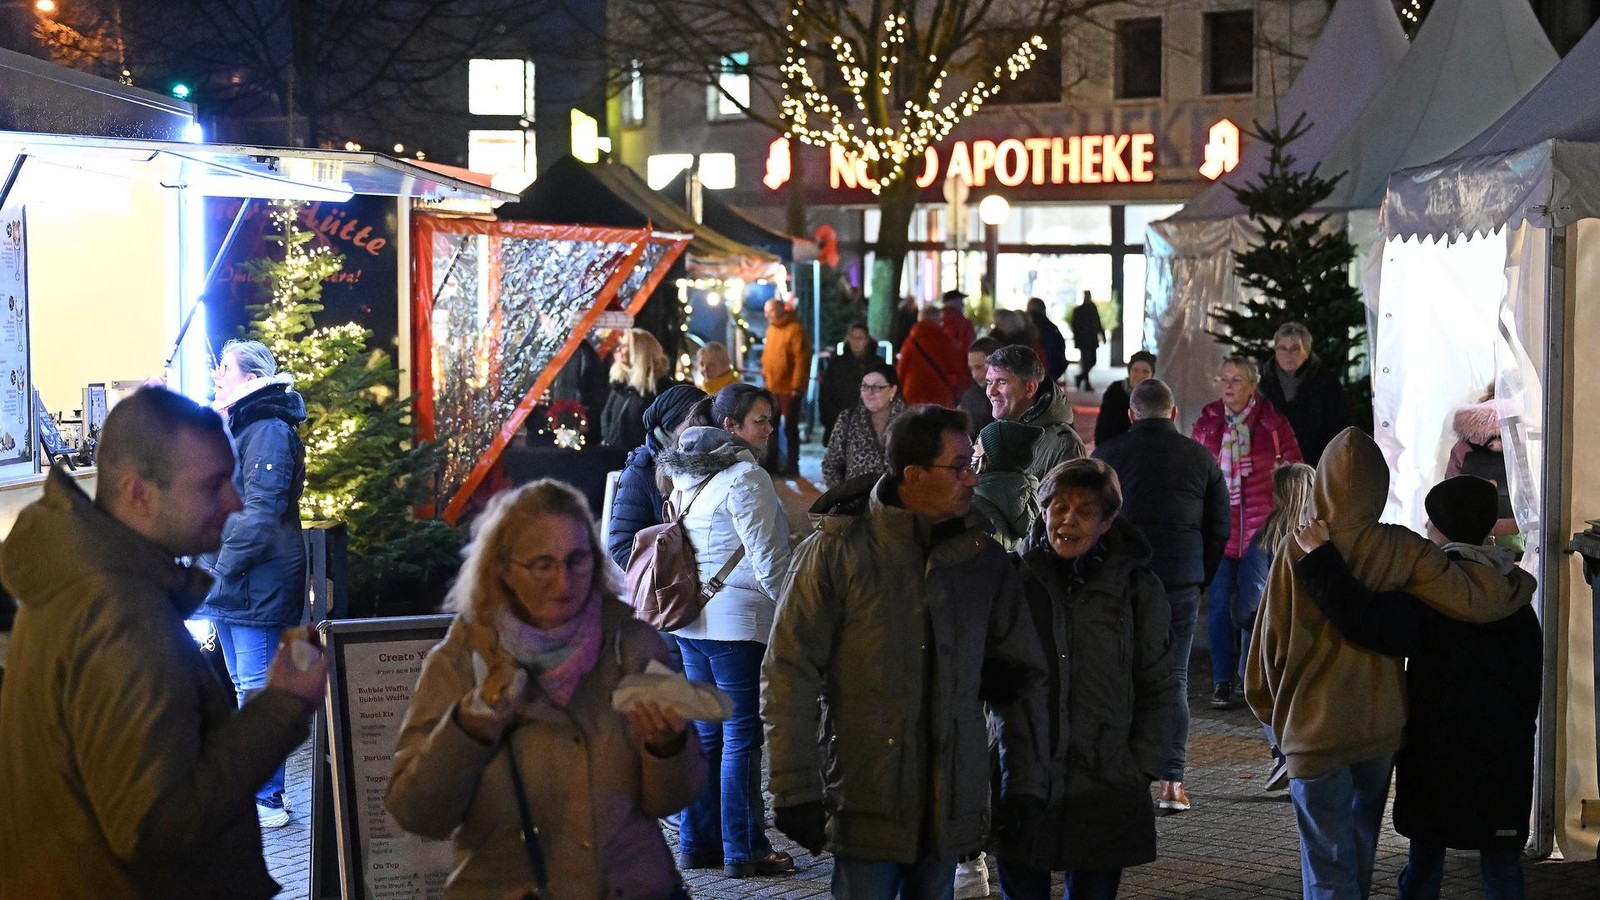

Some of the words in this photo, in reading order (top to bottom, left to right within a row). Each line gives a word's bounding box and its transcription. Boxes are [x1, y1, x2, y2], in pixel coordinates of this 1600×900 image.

[946, 132, 1155, 187] APOTHEKE
[378, 652, 415, 662] Create
[358, 686, 384, 694] Bubble
[385, 684, 409, 692] Waffle
